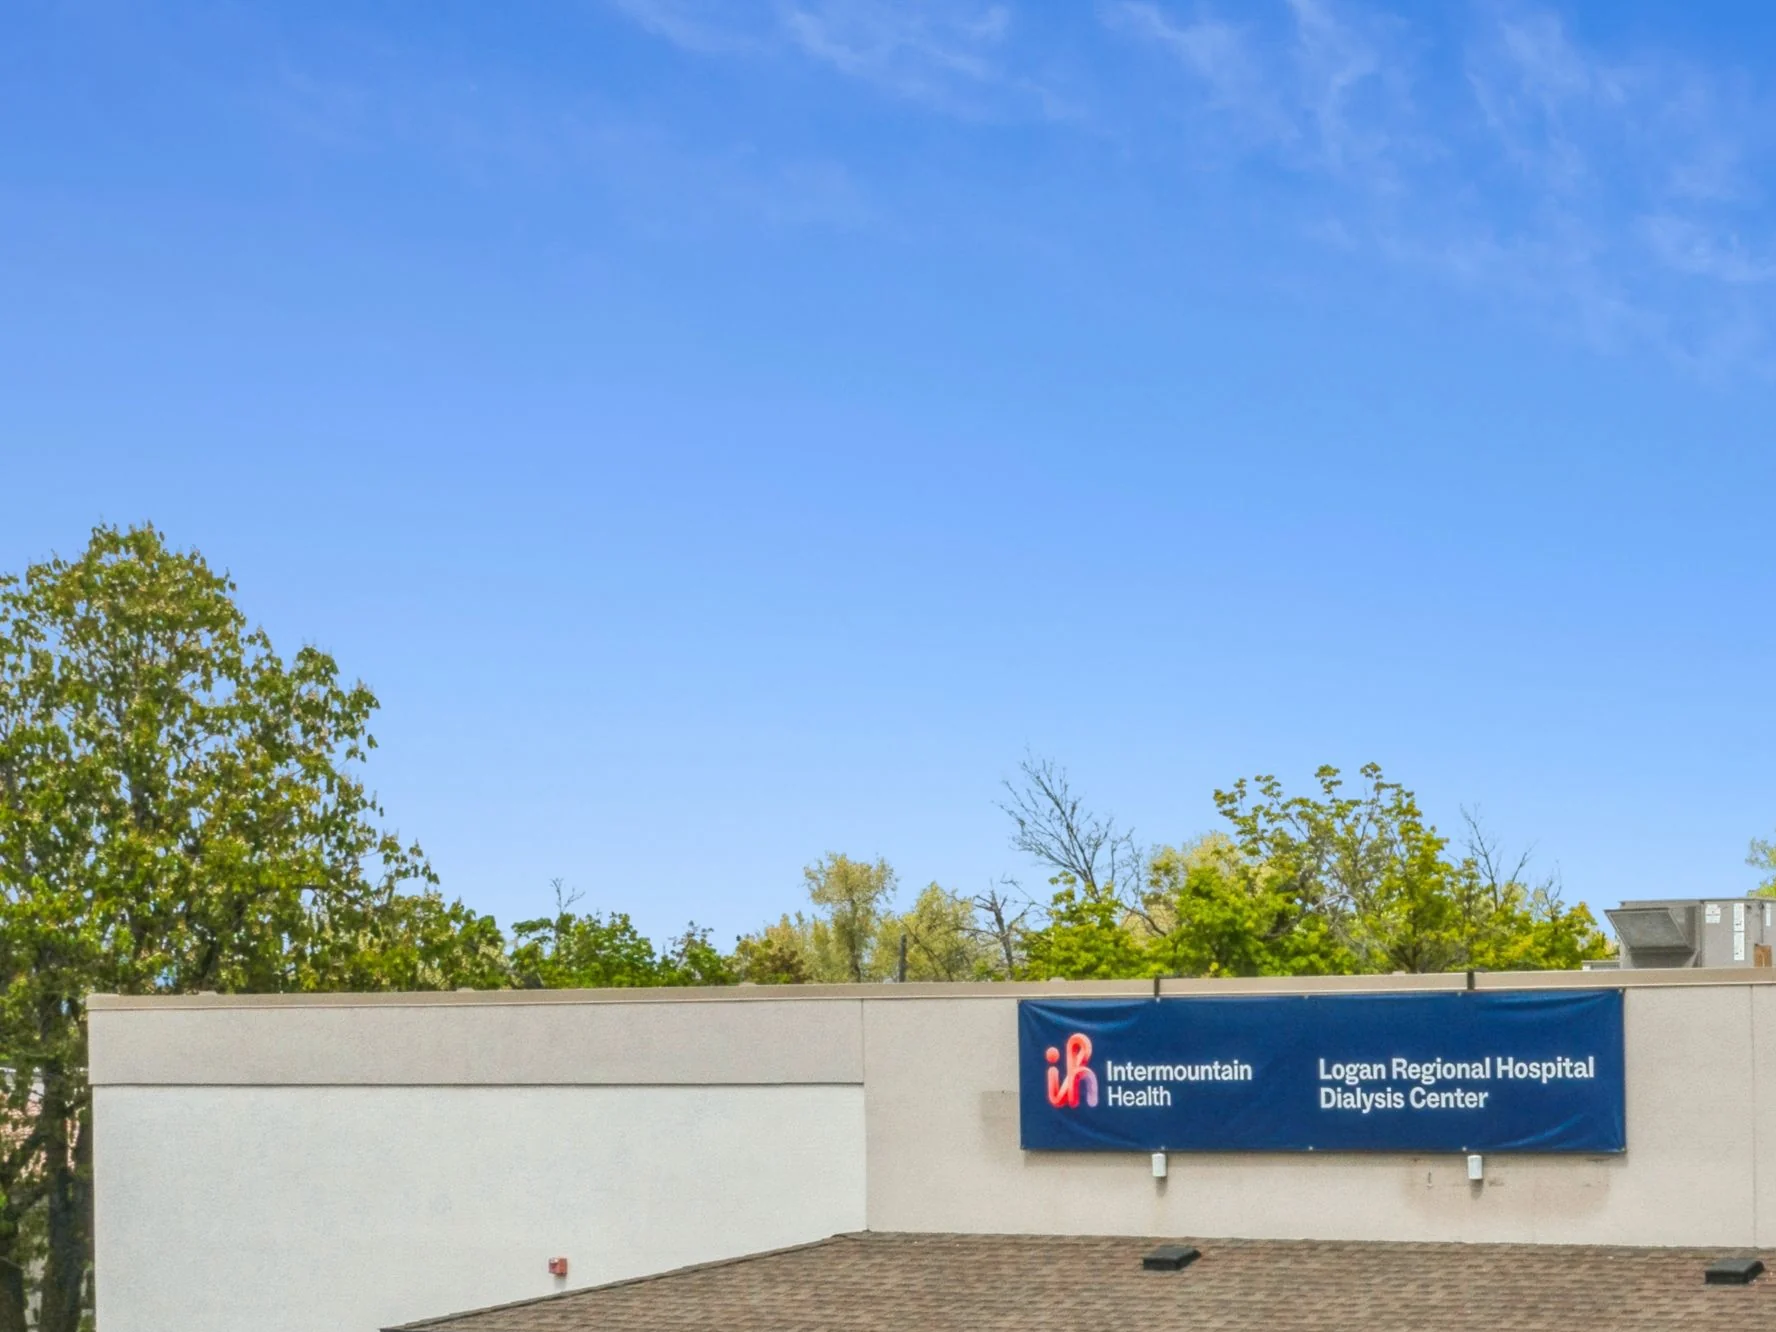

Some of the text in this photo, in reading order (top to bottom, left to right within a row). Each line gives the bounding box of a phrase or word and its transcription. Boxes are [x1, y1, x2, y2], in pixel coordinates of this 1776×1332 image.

[1107, 1060, 1252, 1081] Intermountain
[1319, 1056, 1595, 1085] Logan Regional Hospital
[1107, 1086, 1171, 1106] Health
[1320, 1087, 1489, 1114] Dialysis Center
